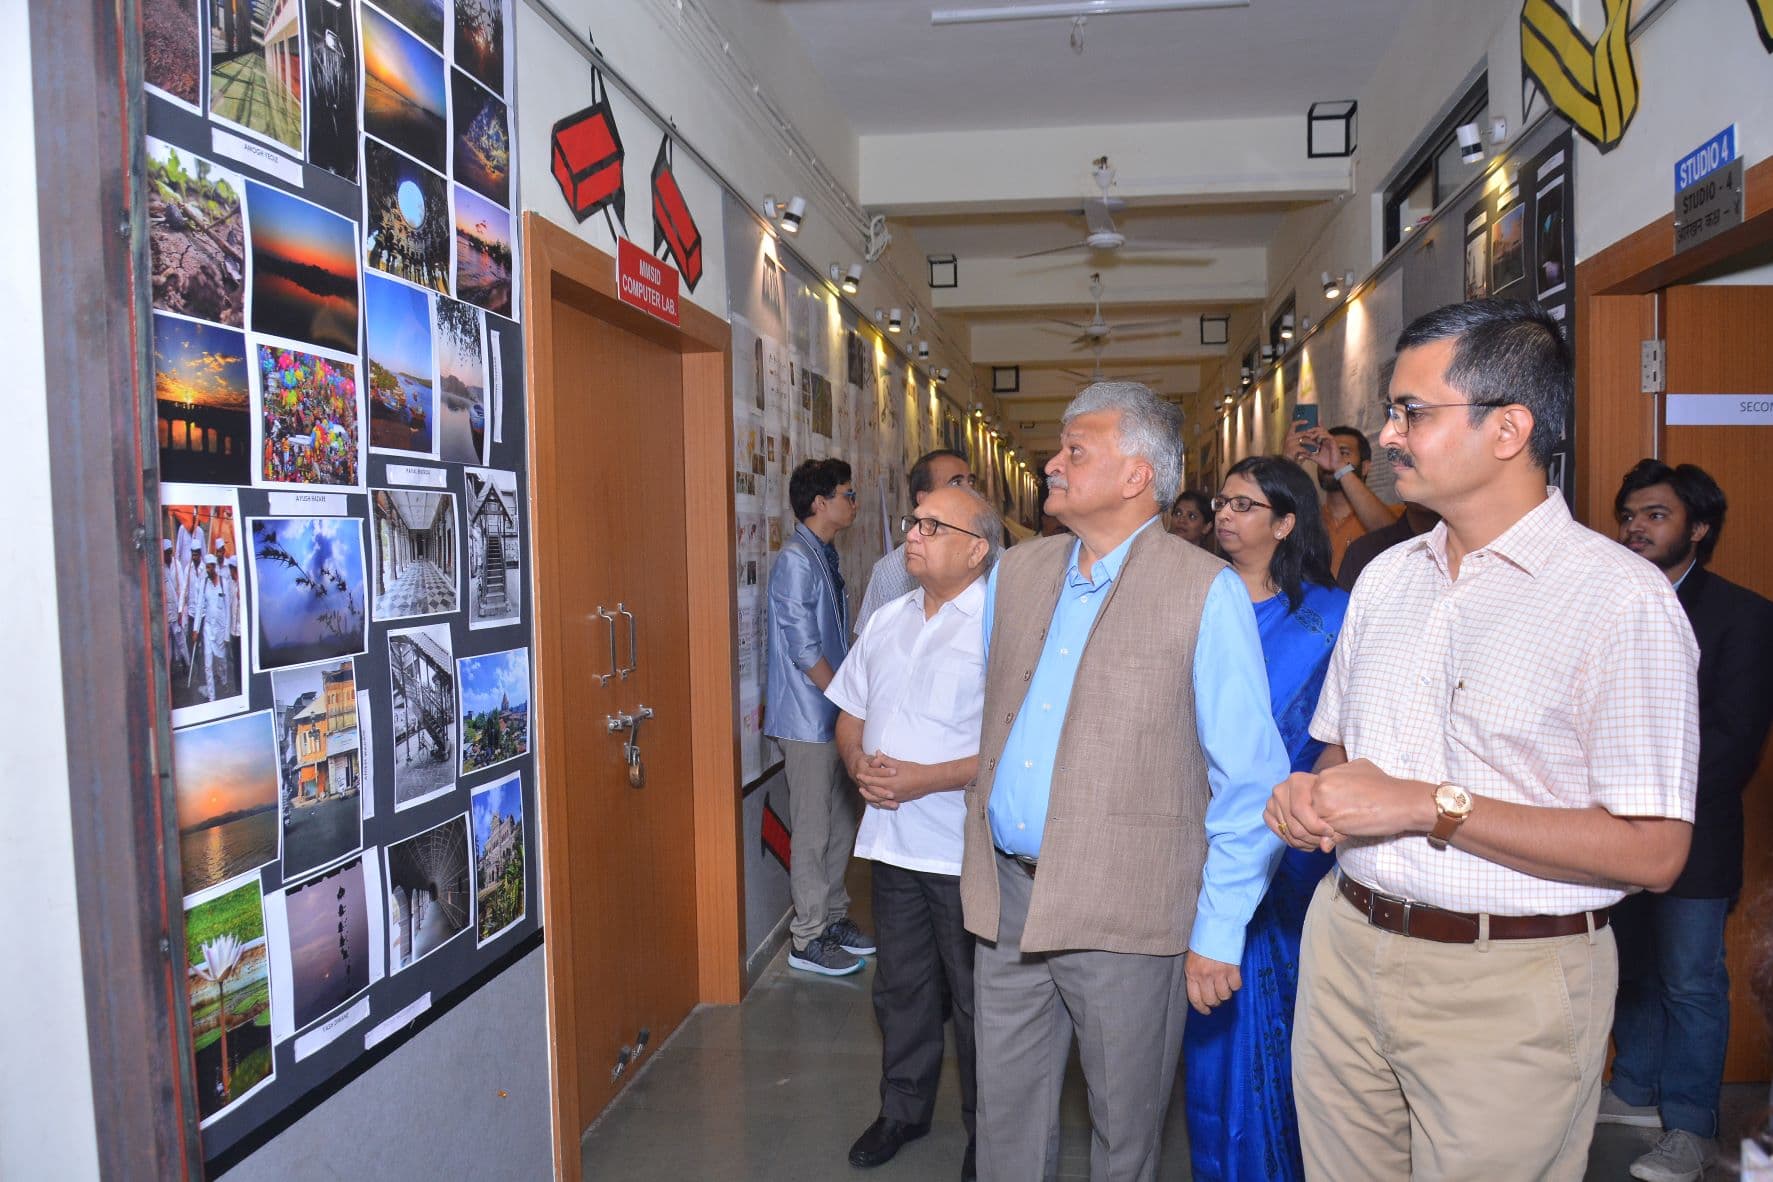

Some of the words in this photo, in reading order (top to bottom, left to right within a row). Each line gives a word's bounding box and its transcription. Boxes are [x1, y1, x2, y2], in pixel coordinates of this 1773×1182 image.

[1680, 142, 1719, 188] STUDIO
[1721, 134, 1729, 161] 4
[1682, 181, 1716, 214] STUDIO
[1726, 170, 1733, 190] 4
[639, 259, 662, 286] MMSID
[622, 274, 661, 309] COMPUTER
[661, 295, 677, 316] LAB.
